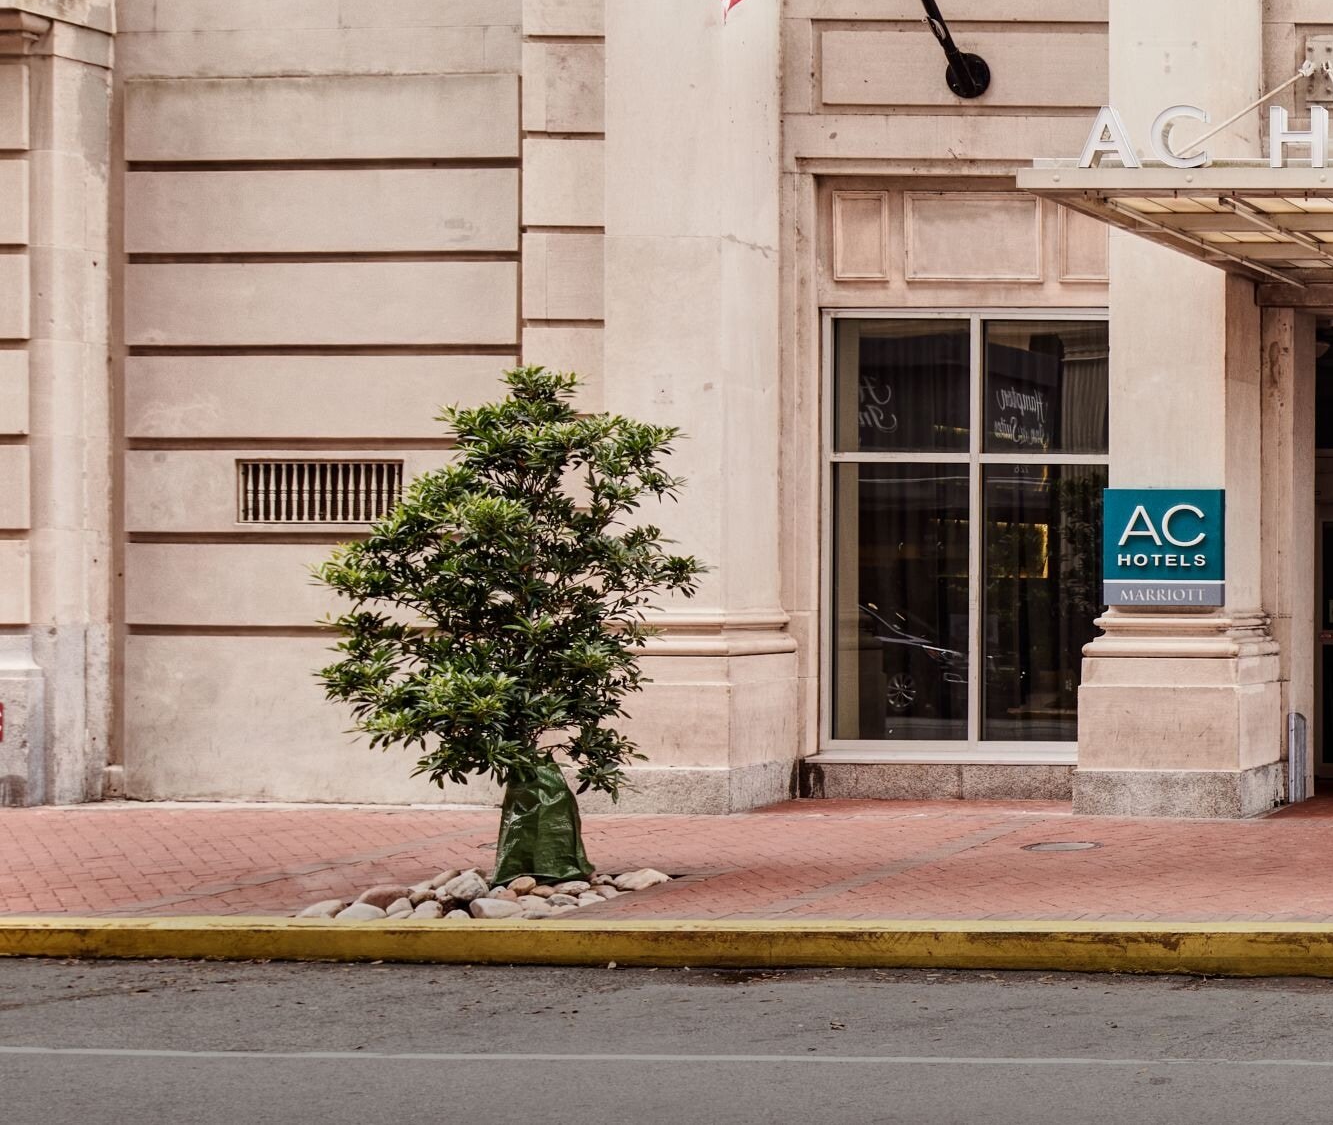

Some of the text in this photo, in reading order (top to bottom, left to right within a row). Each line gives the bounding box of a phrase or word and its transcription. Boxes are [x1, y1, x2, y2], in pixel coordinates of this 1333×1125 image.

[1078, 105, 1208, 169] AC
[1118, 504, 1206, 547] AC
[1118, 554, 1206, 566] HOTELS
[1120, 588, 1206, 602] MARRIOTT
